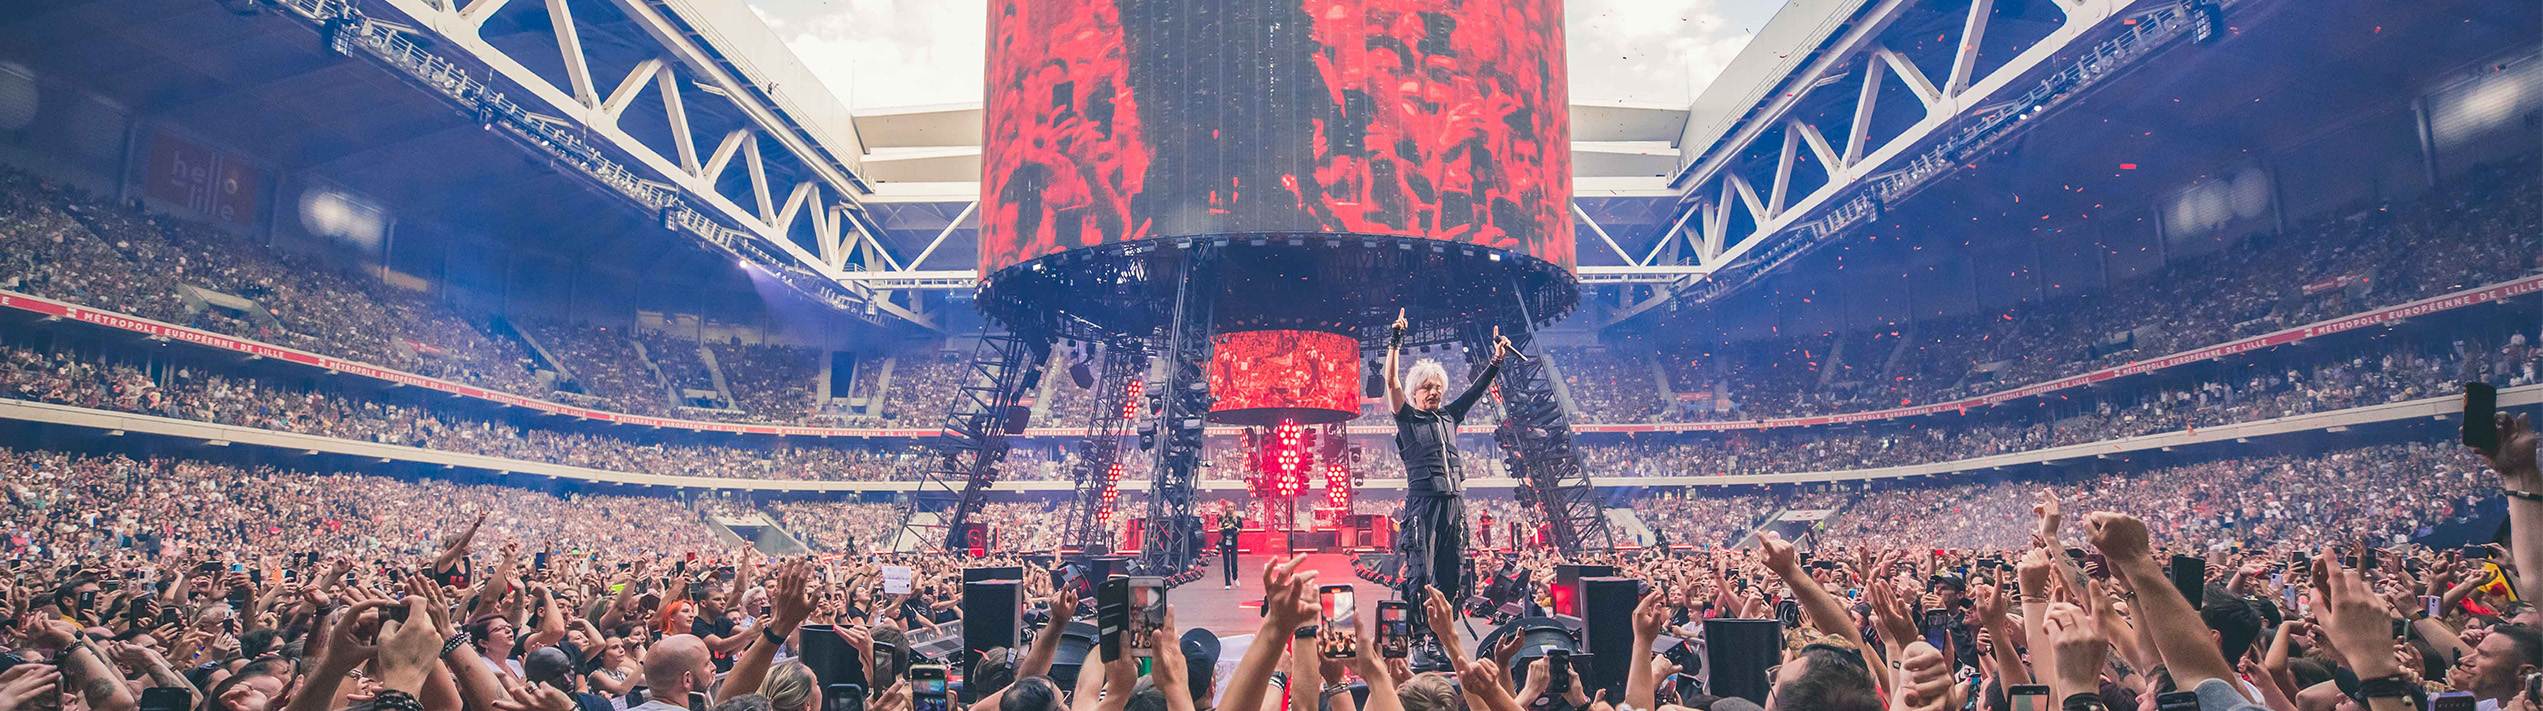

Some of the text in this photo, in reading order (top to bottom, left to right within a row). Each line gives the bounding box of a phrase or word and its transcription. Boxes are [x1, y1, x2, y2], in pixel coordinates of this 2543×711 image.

[2318, 280, 2543, 334] MÉTROPOLE EUROPÉENNE DE LILLE
[84, 312, 284, 358] MÉTROPOLE EUROPÉENNE DE LILLE
[2122, 339, 2267, 375] MÉTROPOLE EUROPÉENNE DE LILLE
[329, 361, 460, 392] MÉTROPOLE EUROPÉENNE DE LILLE
[2061, 381, 2069, 389] DE
[2072, 377, 2090, 387] LILLE
[570, 408, 586, 416] LILLE
